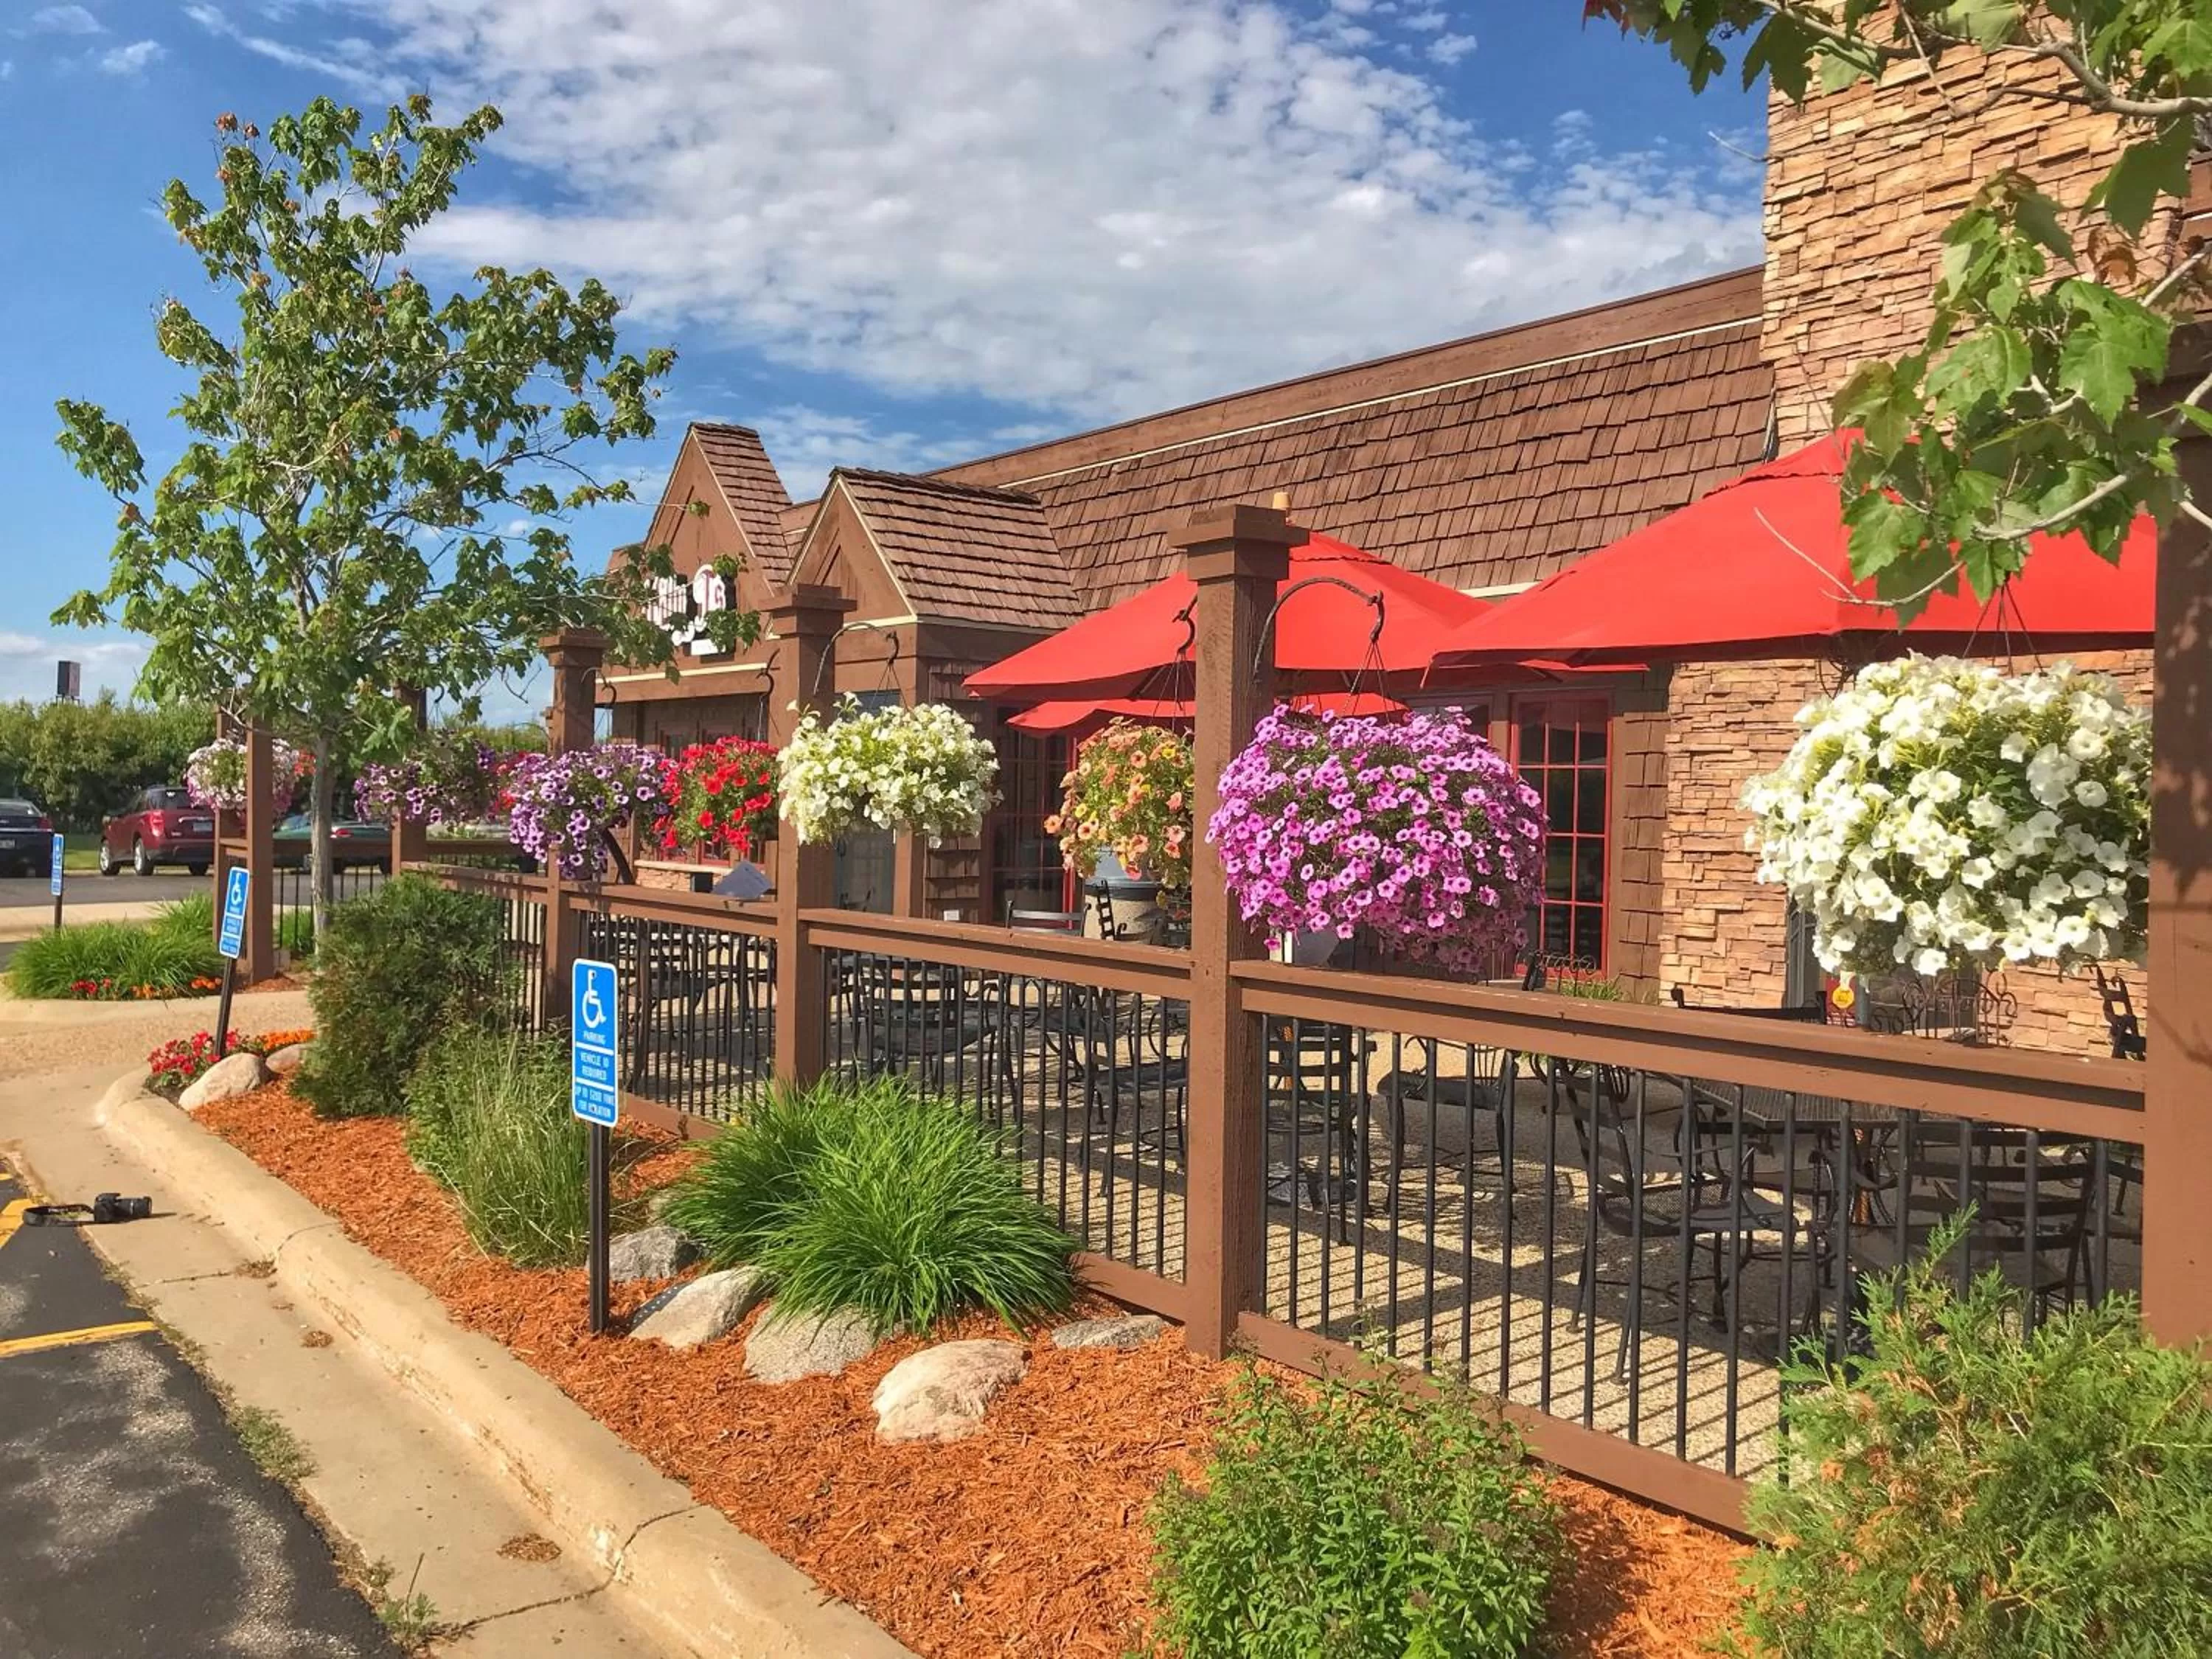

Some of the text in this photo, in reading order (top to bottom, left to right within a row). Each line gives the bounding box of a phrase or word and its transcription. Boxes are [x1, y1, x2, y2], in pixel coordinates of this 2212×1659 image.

[583, 1030, 606, 1045] PARKING
[580, 1051, 602, 1066] VEHICLE
[582, 1065, 607, 1080] REQUIRED
